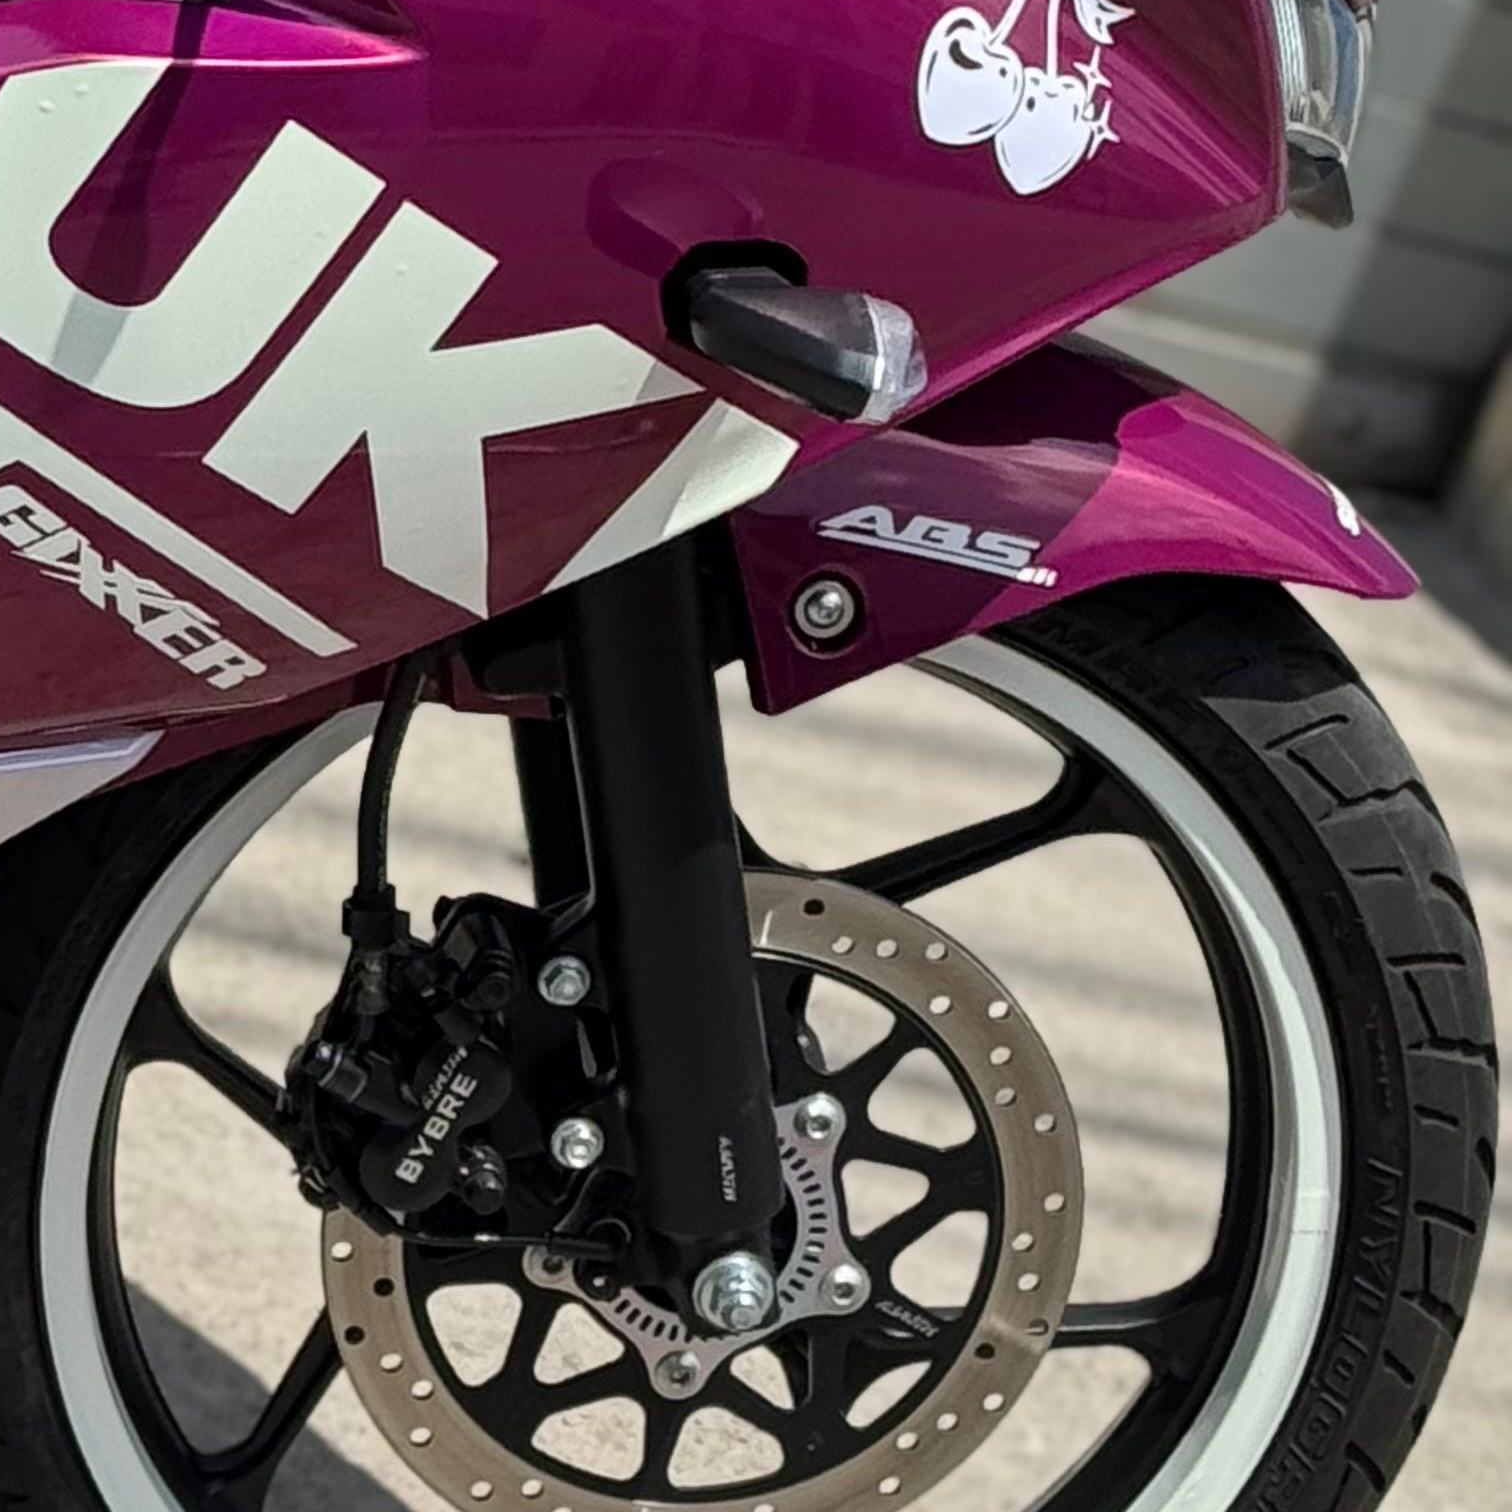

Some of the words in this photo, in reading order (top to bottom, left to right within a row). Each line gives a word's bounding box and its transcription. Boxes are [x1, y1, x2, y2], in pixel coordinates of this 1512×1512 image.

[820, 504, 1041, 570] ABS
[395, 1073, 478, 1184] BYBRE
[1256, 1154, 1405, 1512] NYLOGR
